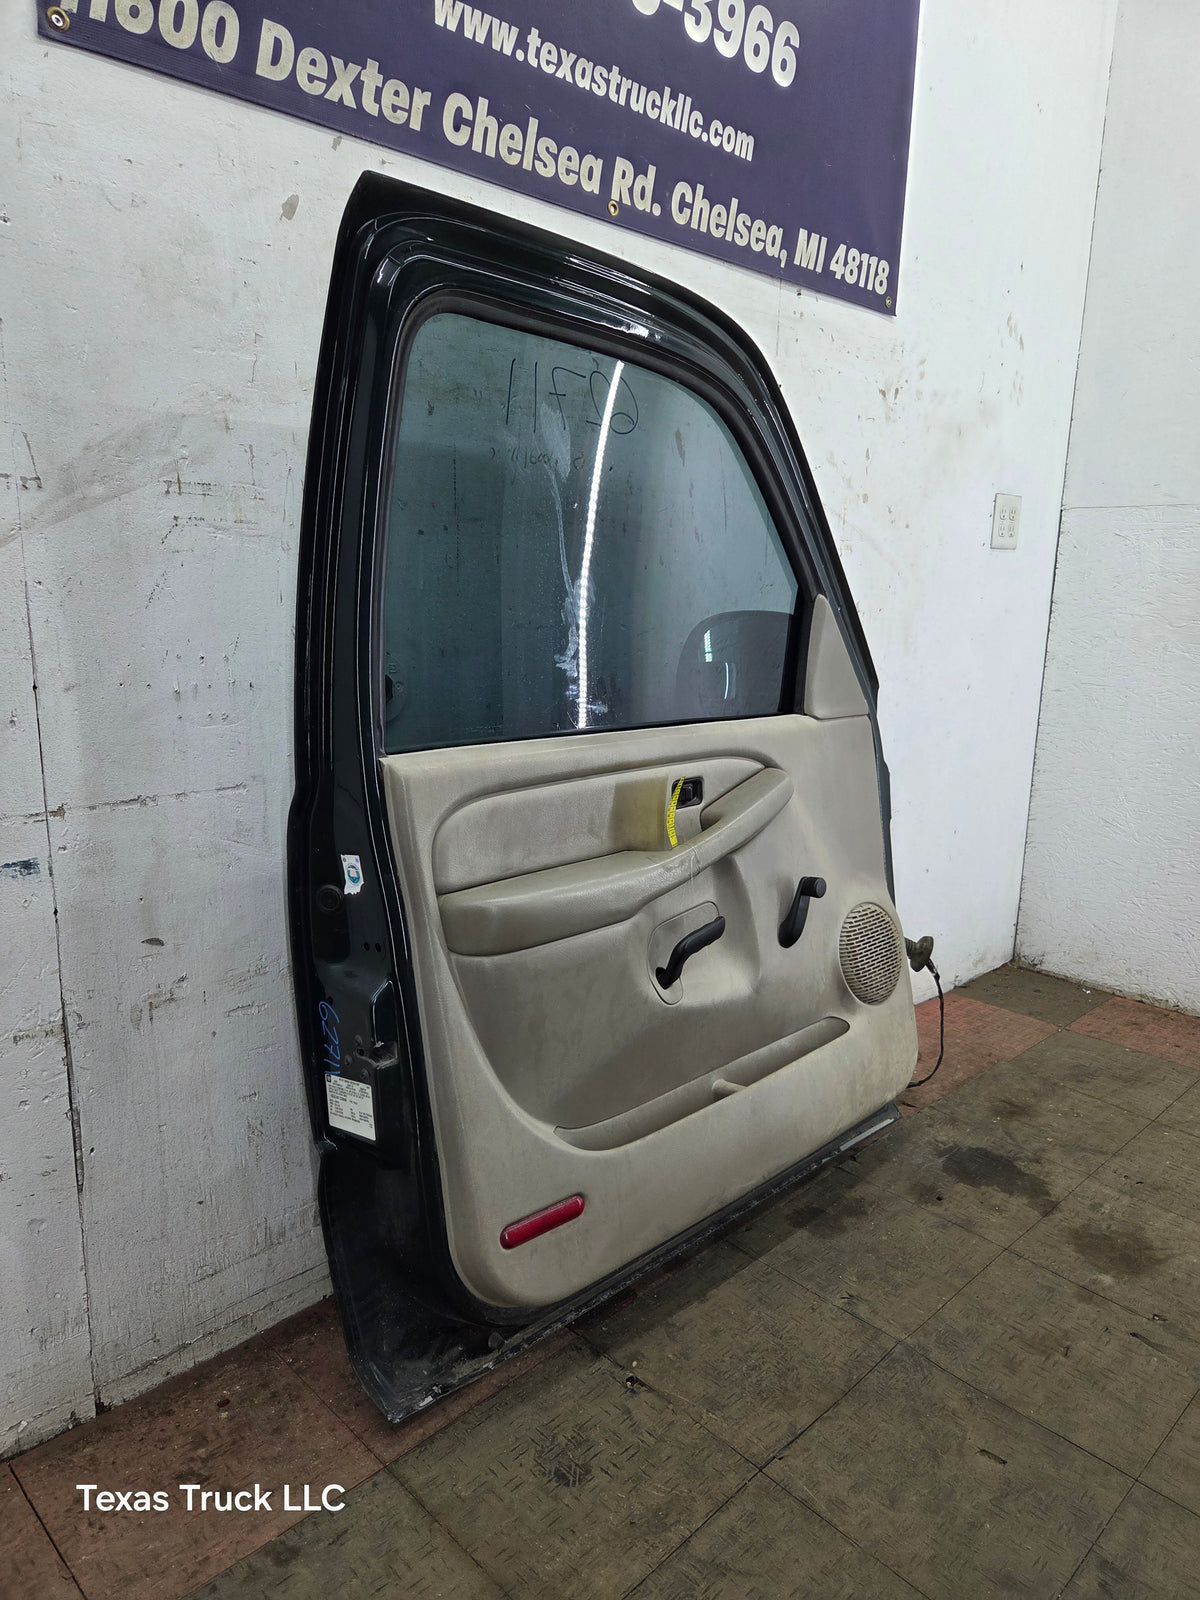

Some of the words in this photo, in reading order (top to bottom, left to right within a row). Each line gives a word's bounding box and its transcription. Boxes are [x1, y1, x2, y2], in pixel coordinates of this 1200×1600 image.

[434, 0, 756, 162] www.texastruckllc.com
[633, 0, 800, 88] -3966
[255, 18, 431, 132] Dexter
[442, 92, 603, 195] Chelsea
[611, 156, 661, 217] Rd.
[671, 181, 787, 268] Chelsea,
[794, 229, 828, 273] MI
[830, 244, 890, 296] 48118
